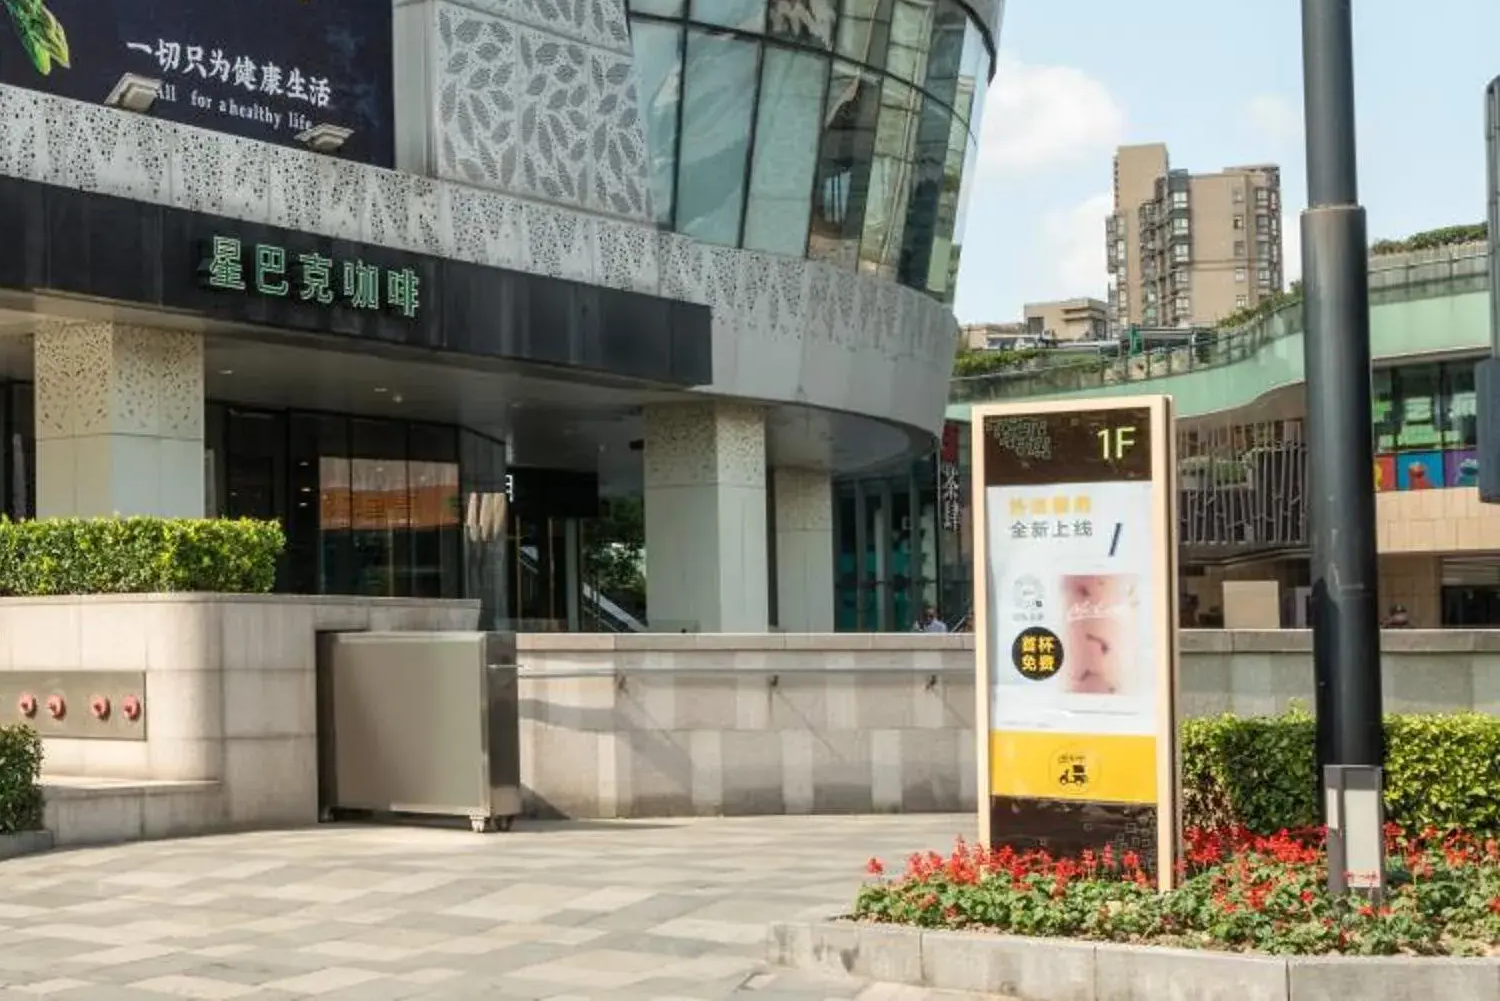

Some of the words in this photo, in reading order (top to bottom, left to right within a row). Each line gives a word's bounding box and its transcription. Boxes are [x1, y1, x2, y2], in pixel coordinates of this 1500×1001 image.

[126, 38, 331, 107] 一切只为健康生活
[190, 89, 212, 110] for
[229, 98, 282, 130] healthy
[209, 235, 421, 318] 星巴克咖啡
[1097, 426, 1137, 460] 1F
[1010, 519, 1094, 540] 全新上线
